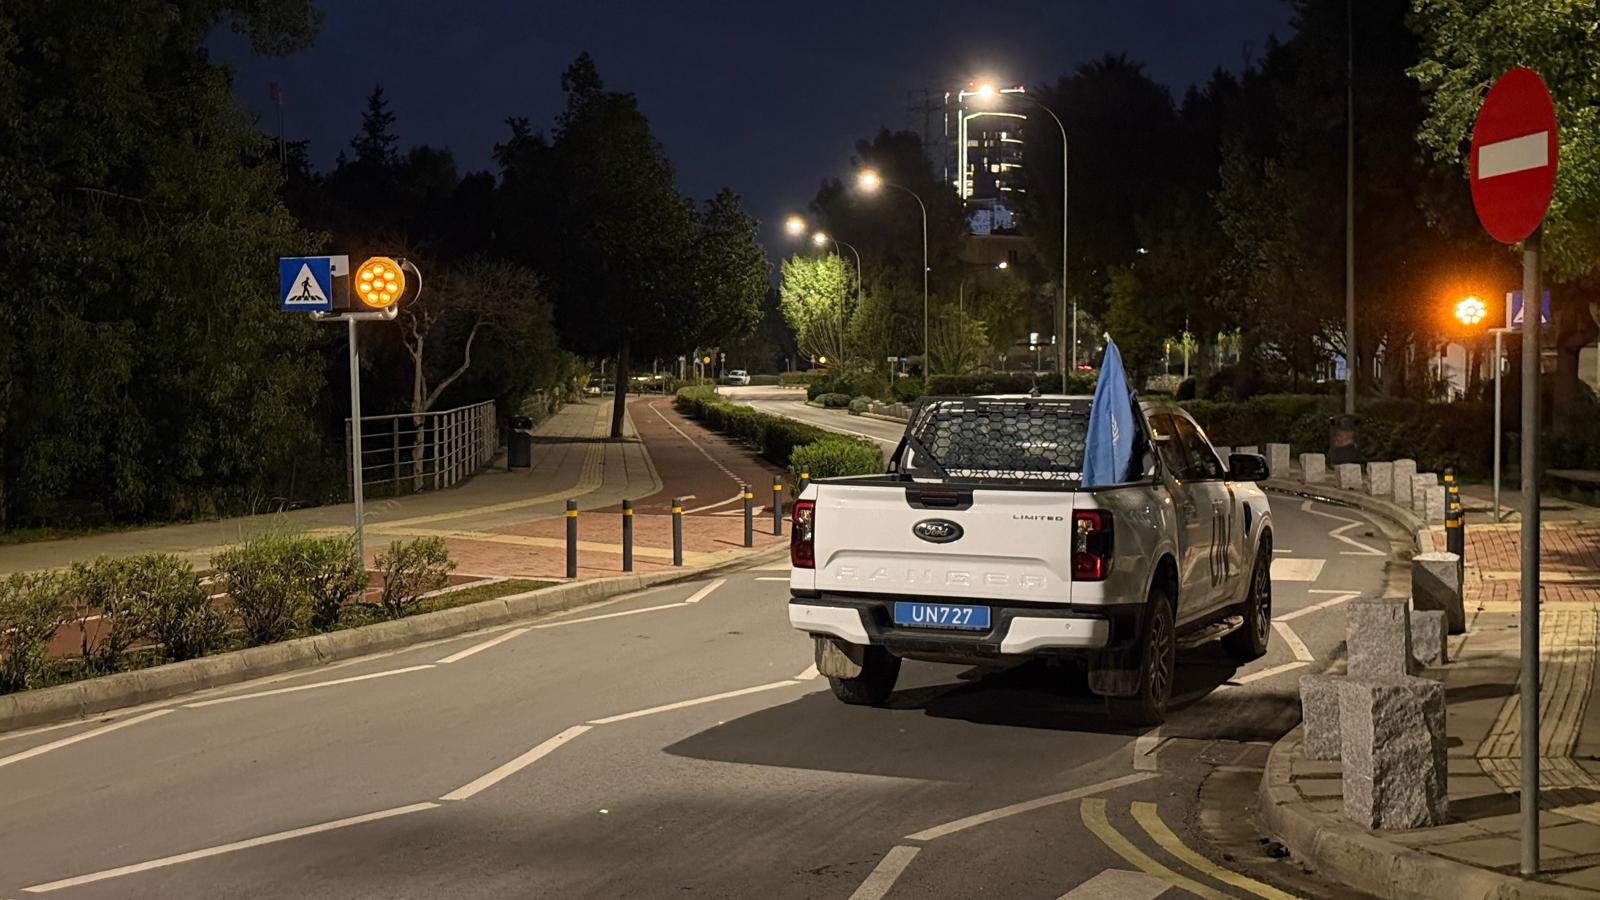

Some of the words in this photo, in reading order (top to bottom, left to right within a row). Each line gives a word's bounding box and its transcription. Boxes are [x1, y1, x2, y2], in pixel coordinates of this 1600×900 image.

[924, 524, 949, 537] Ford
[1210, 513, 1231, 588] UN
[835, 567, 1047, 590] RANGER
[911, 605, 973, 625] UN727
